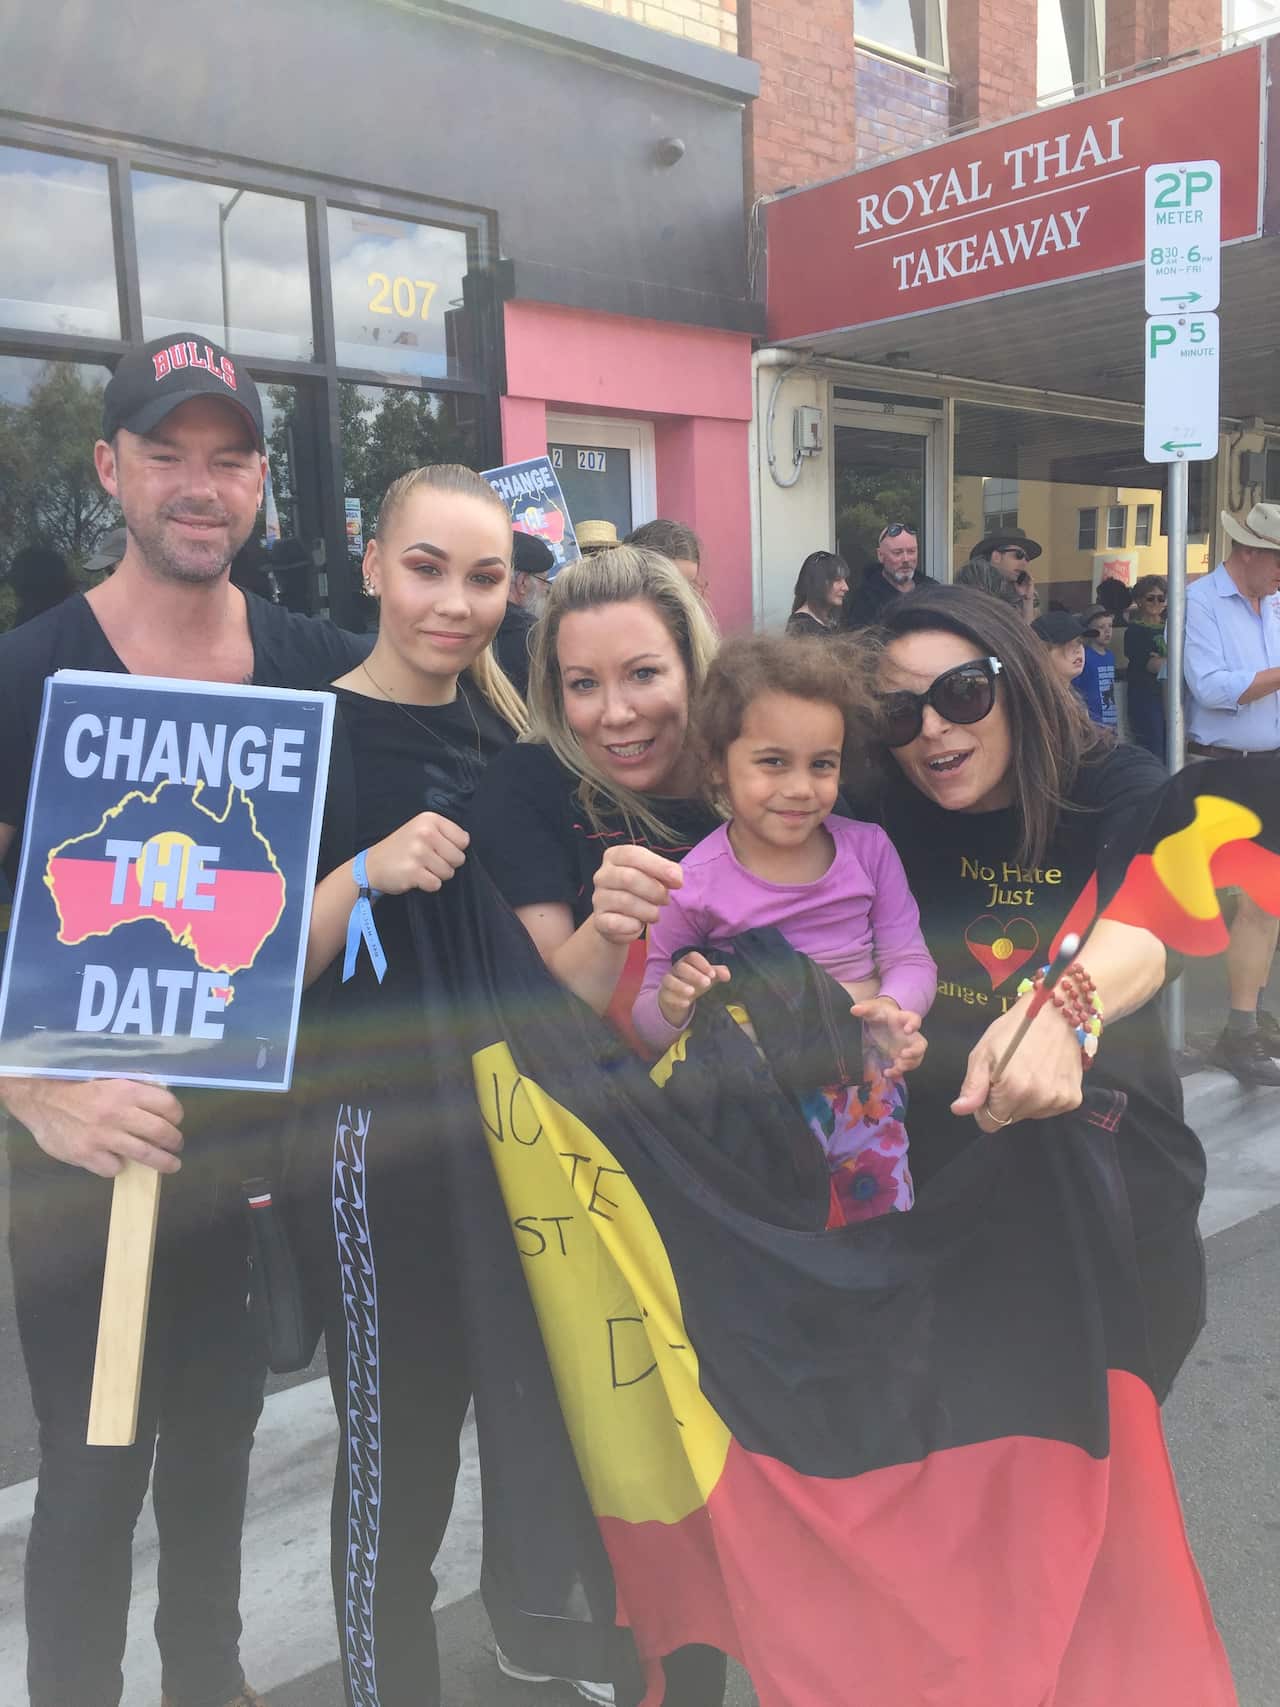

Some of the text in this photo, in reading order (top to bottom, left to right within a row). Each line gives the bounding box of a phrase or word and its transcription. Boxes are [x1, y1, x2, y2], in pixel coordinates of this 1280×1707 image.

[857, 117, 1124, 235] ROYAL THAI
[1154, 171, 1213, 208] 2P
[1156, 210, 1203, 225] METER
[893, 205, 1090, 290] TAKEAWAY
[367, 272, 438, 320] 207
[1150, 322, 1206, 359] P 5
[1180, 347, 1215, 358] MINUTE
[152, 341, 238, 391] BULLS
[579, 451, 606, 470] 207
[63, 713, 305, 793] CHANGE
[105, 839, 220, 912] THE
[960, 857, 1063, 884] No Hate
[985, 883, 1035, 908] Just
[75, 964, 230, 1040] DATE
[937, 980, 988, 1006] ange
